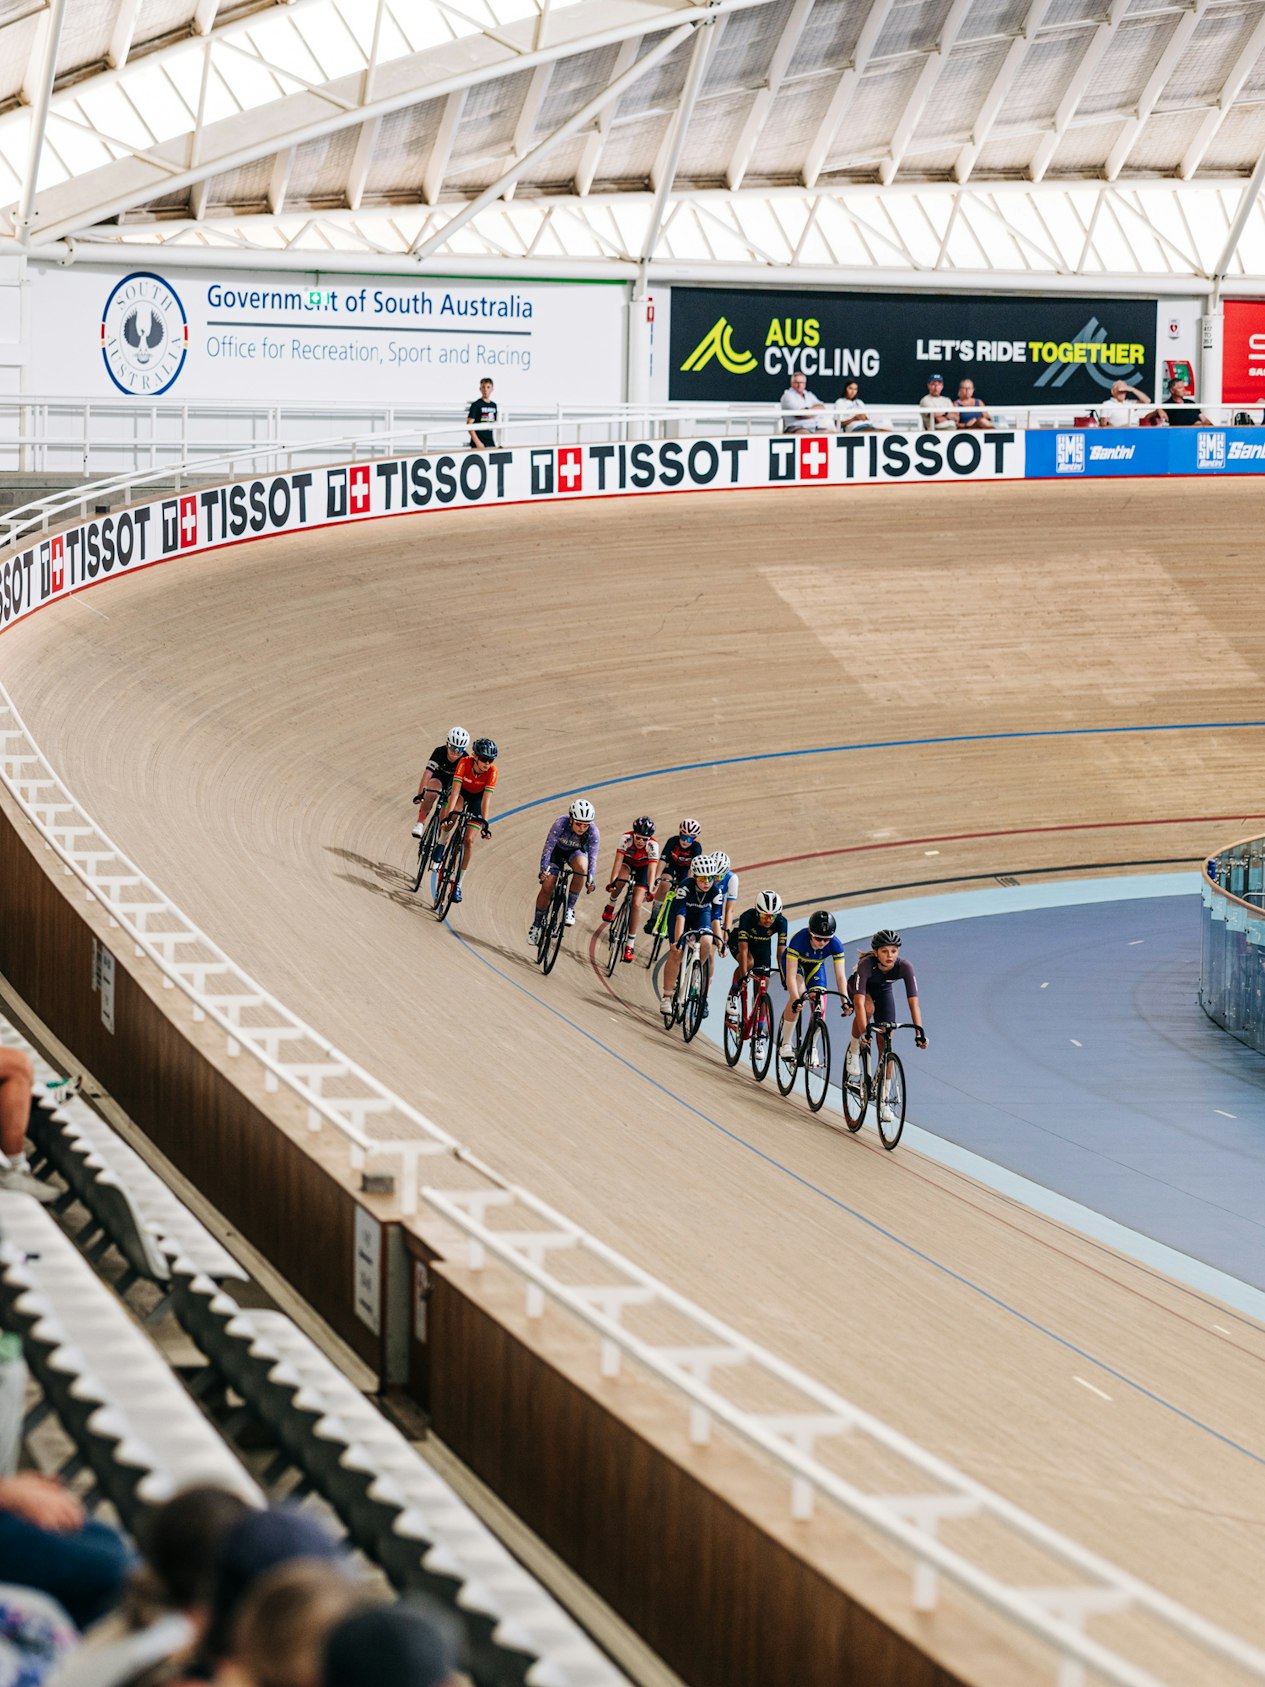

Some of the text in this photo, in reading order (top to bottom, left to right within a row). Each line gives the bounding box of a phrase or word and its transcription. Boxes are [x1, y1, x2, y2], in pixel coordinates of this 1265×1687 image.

[116, 281, 173, 312] SOUTH
[345, 289, 367, 313] of
[373, 291, 432, 315] South
[440, 294, 533, 319] Australia
[764, 317, 821, 348] AUS
[107, 334, 182, 391] AUSTRALIA
[206, 335, 532, 372] Office for Recreation, Sport and Racing
[764, 346, 880, 377] CYCLING
[916, 339, 1145, 365] LET'S RIDE TOGETHER
[589, 439, 749, 491] TISSOT
[836, 432, 1015, 478] TISSOT
[1089, 444, 1136, 461] Santini
[376, 451, 513, 510] TISSOT
[201, 473, 313, 543] TISSOT
[66, 506, 151, 586] TISSOT
